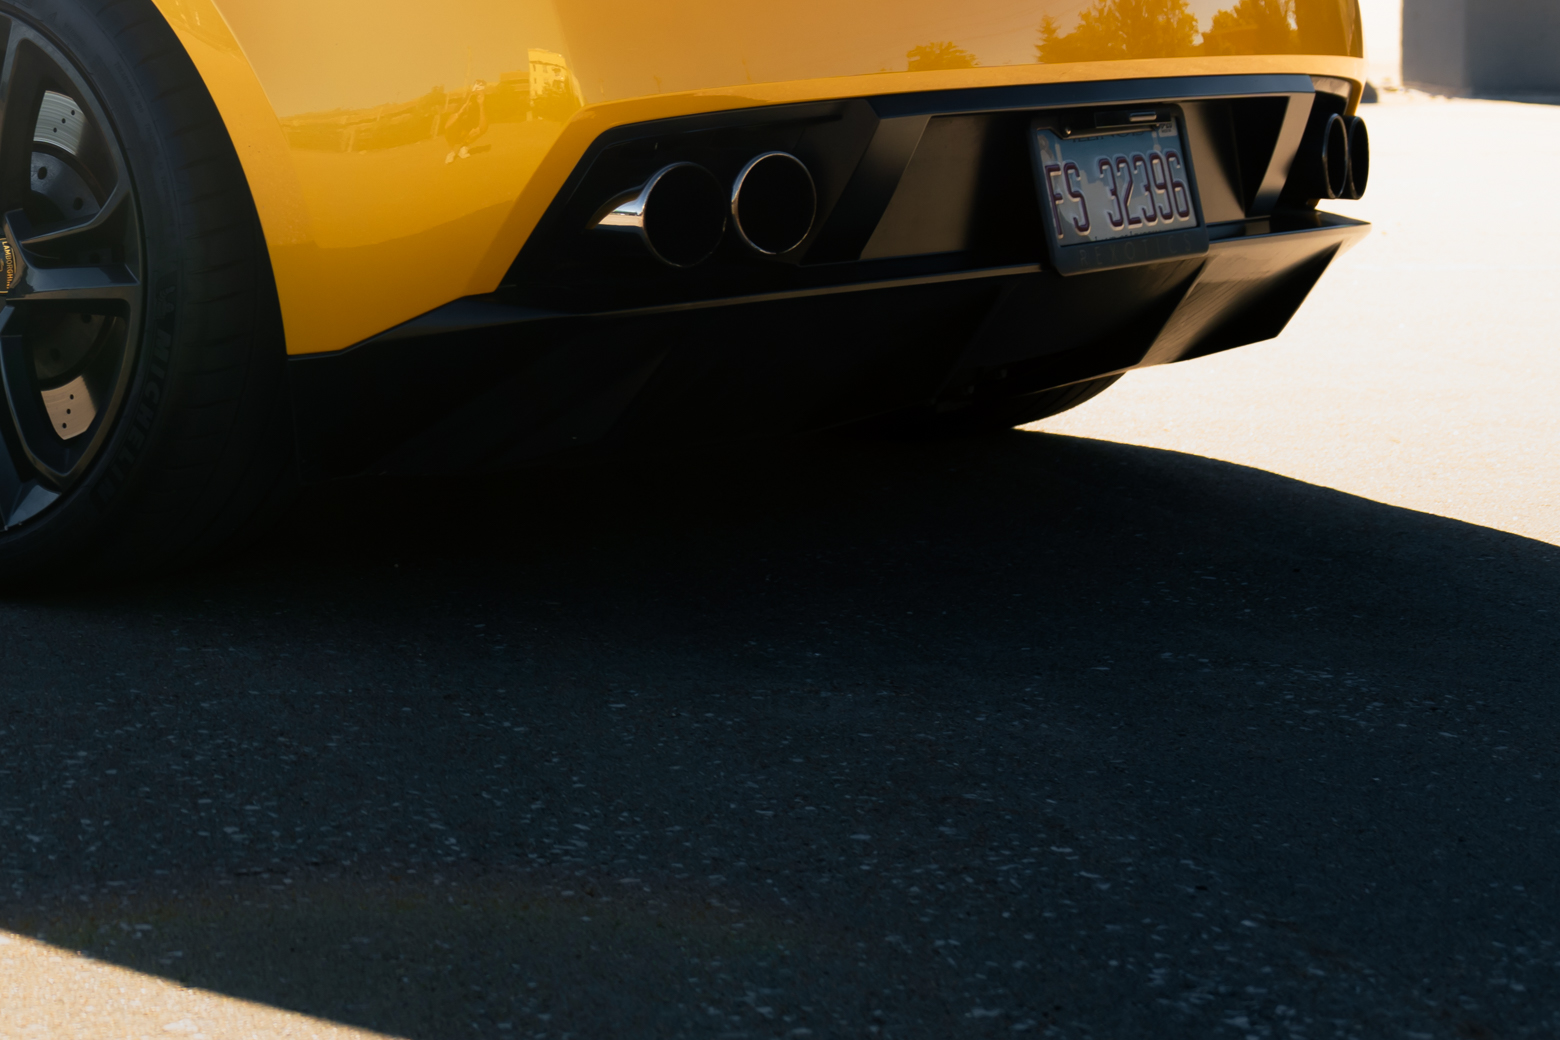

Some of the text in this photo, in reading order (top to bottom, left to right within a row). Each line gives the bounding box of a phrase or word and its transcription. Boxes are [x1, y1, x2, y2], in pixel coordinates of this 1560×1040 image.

[1044, 151, 1191, 239] FS 32396
[1079, 234, 1193, 267] REXOTICS
[97, 329, 172, 504] MICHELIN
